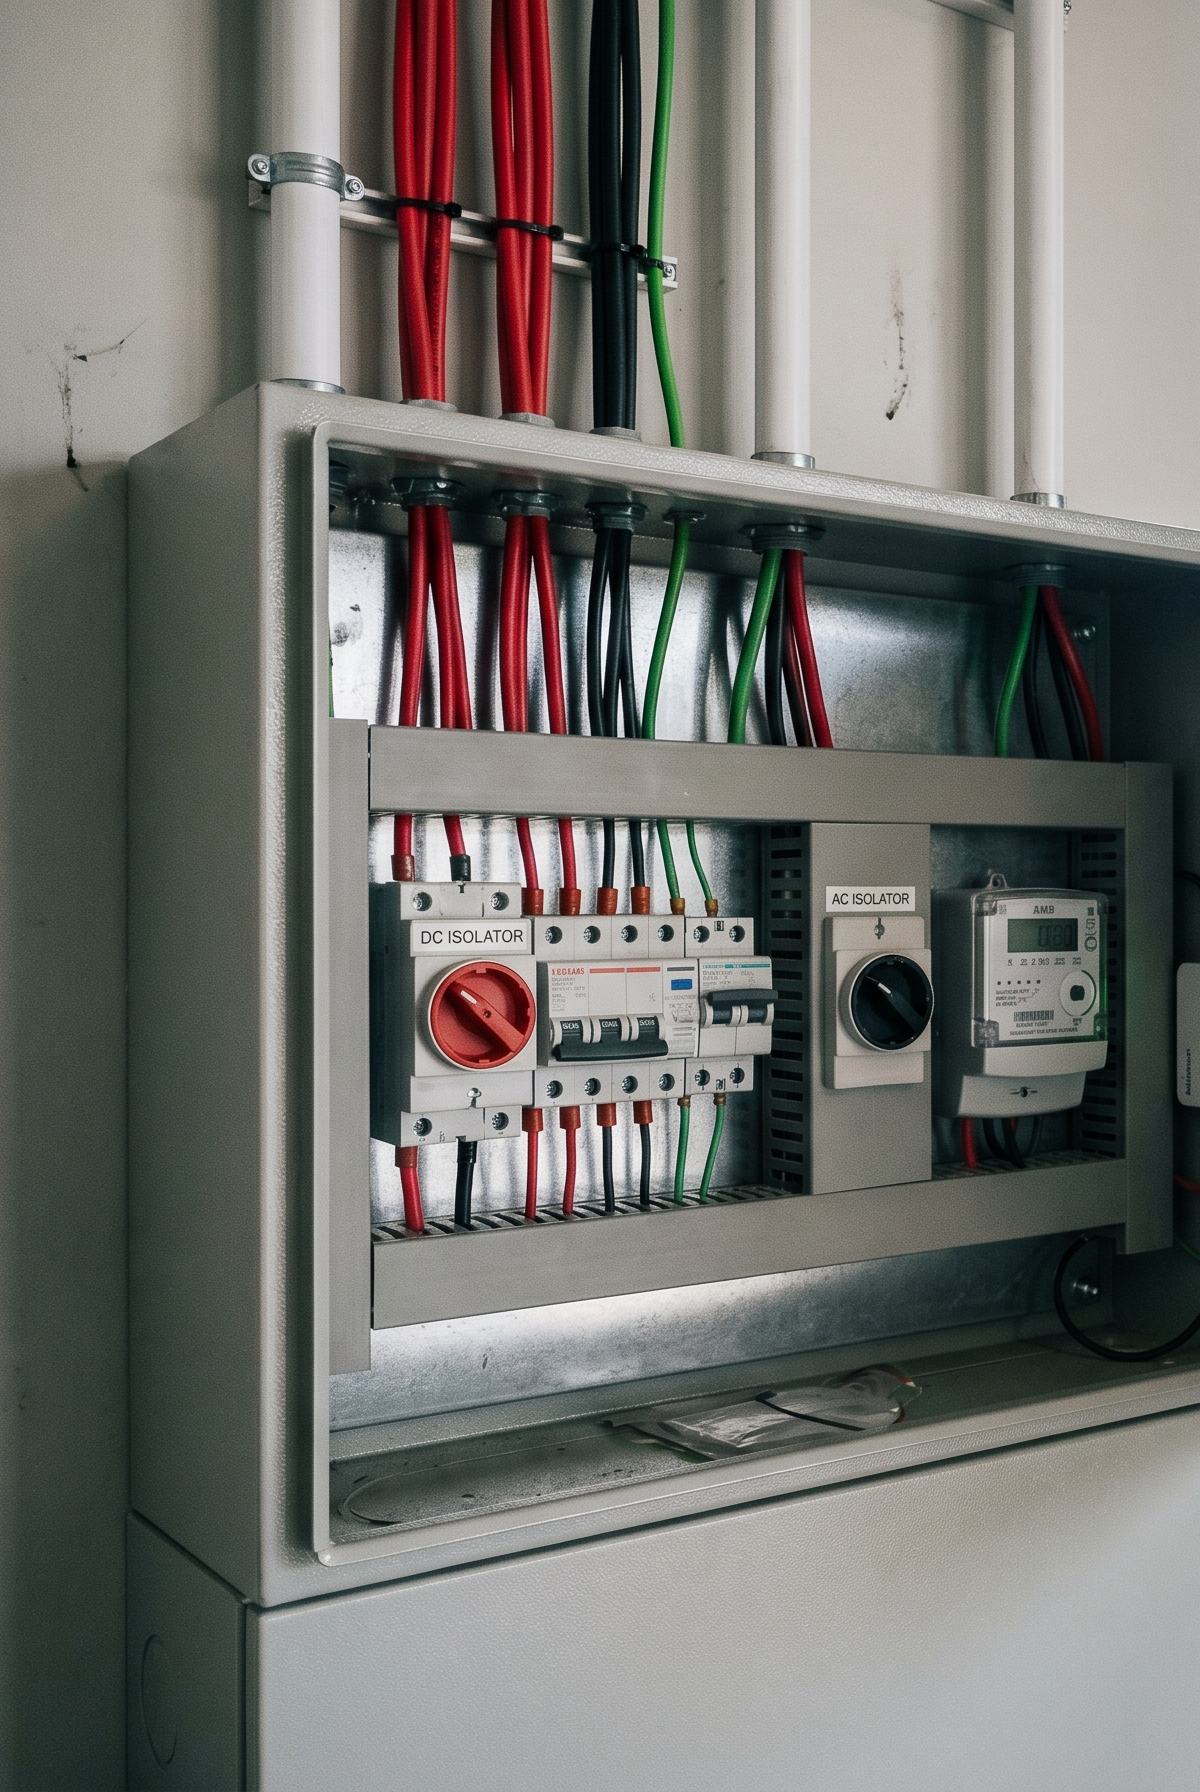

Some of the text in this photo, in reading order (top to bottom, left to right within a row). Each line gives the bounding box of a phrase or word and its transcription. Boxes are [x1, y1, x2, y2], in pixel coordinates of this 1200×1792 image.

[832, 893, 910, 905] AC ISOLATOR
[1033, 905, 1055, 914] AMB
[421, 929, 524, 944] DC ISOLATOR
